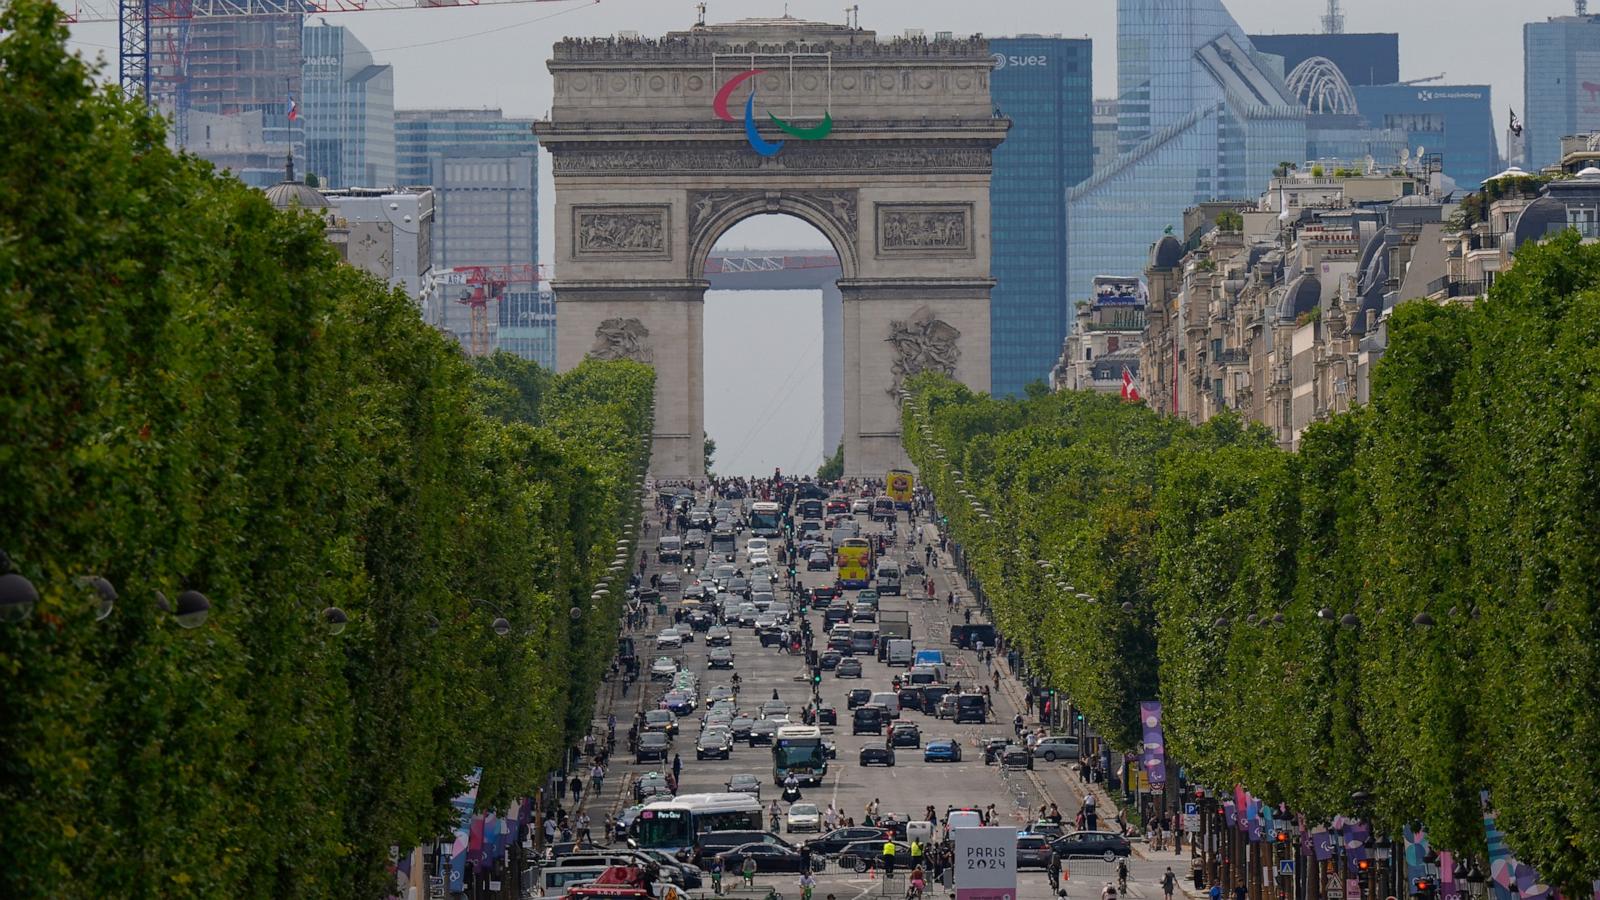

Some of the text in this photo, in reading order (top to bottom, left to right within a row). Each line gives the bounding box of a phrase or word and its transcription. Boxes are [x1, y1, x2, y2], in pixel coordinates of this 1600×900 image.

[1009, 55, 1047, 66] suez
[967, 847, 1006, 857] PARIS
[967, 859, 1006, 869] 2024
